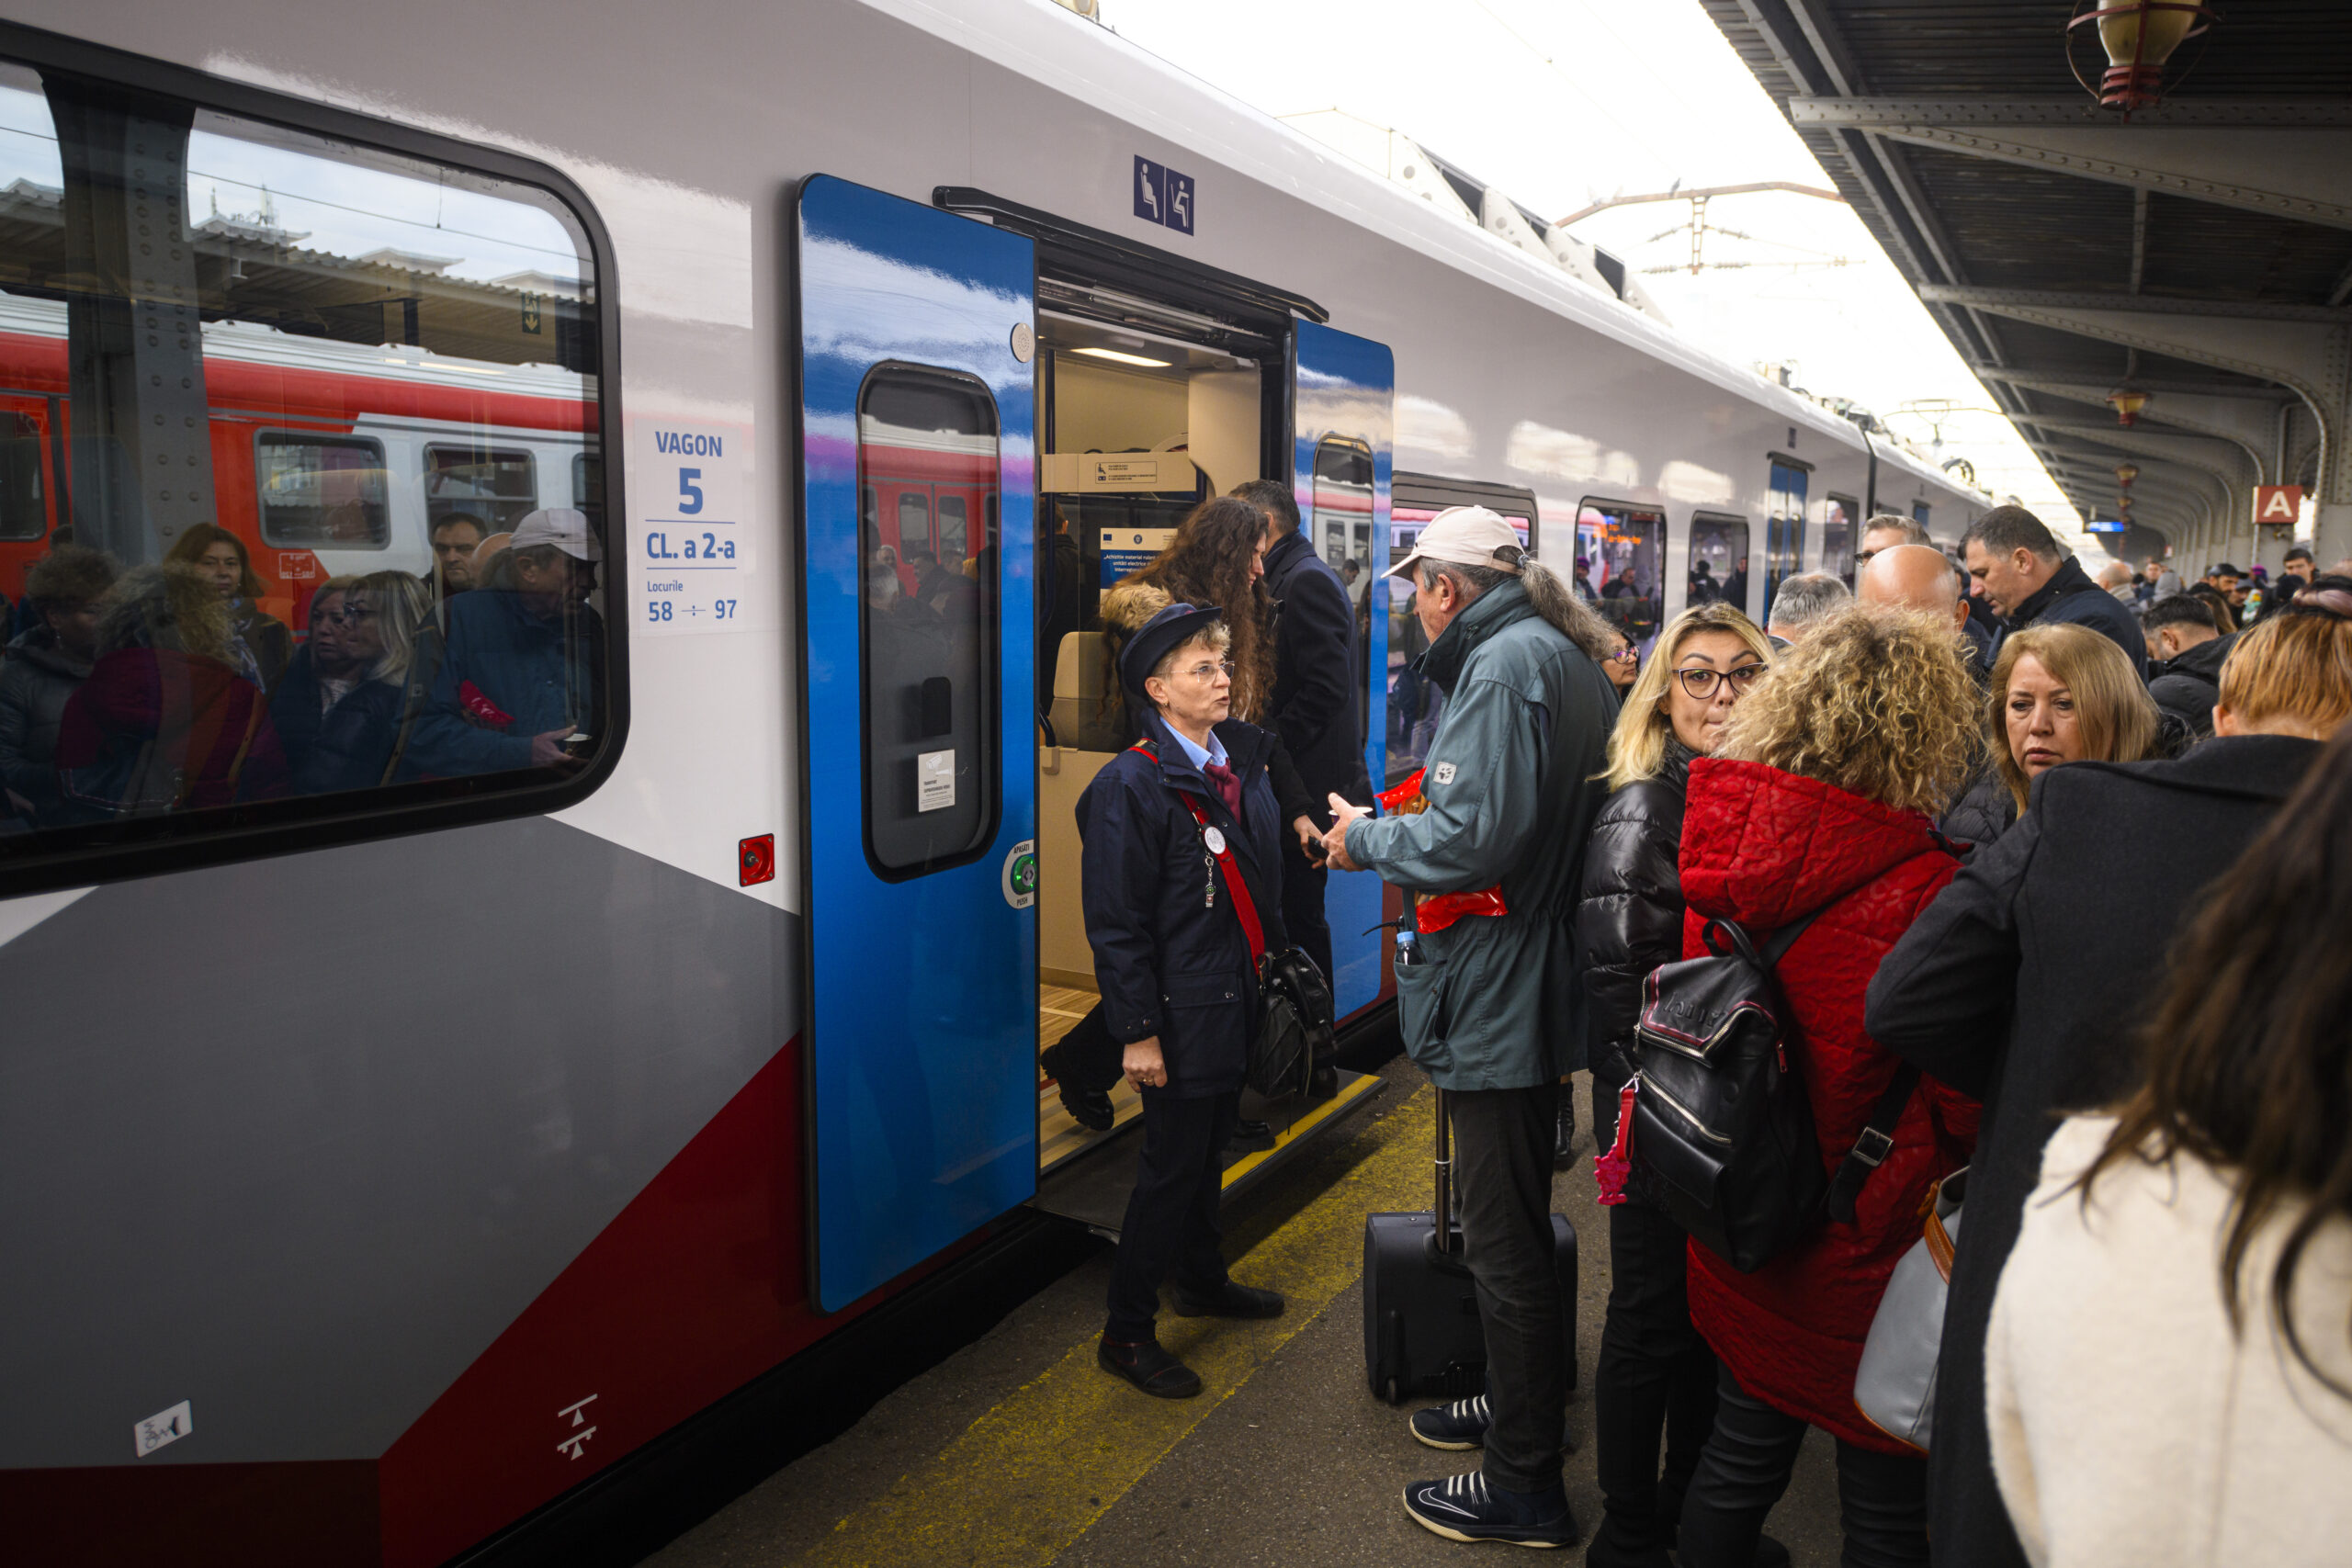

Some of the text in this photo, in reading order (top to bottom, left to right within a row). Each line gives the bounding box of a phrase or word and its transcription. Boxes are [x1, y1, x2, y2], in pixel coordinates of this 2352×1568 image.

[655, 431, 722, 457] VAGON
[678, 467, 704, 514] 5
[2263, 491, 2293, 517] A
[646, 532, 736, 559] CL. a 2-a
[647, 581, 684, 592] Locurile
[649, 602, 673, 622] 58
[715, 600, 737, 619] 97
[1016, 897, 1028, 908] PUSH
